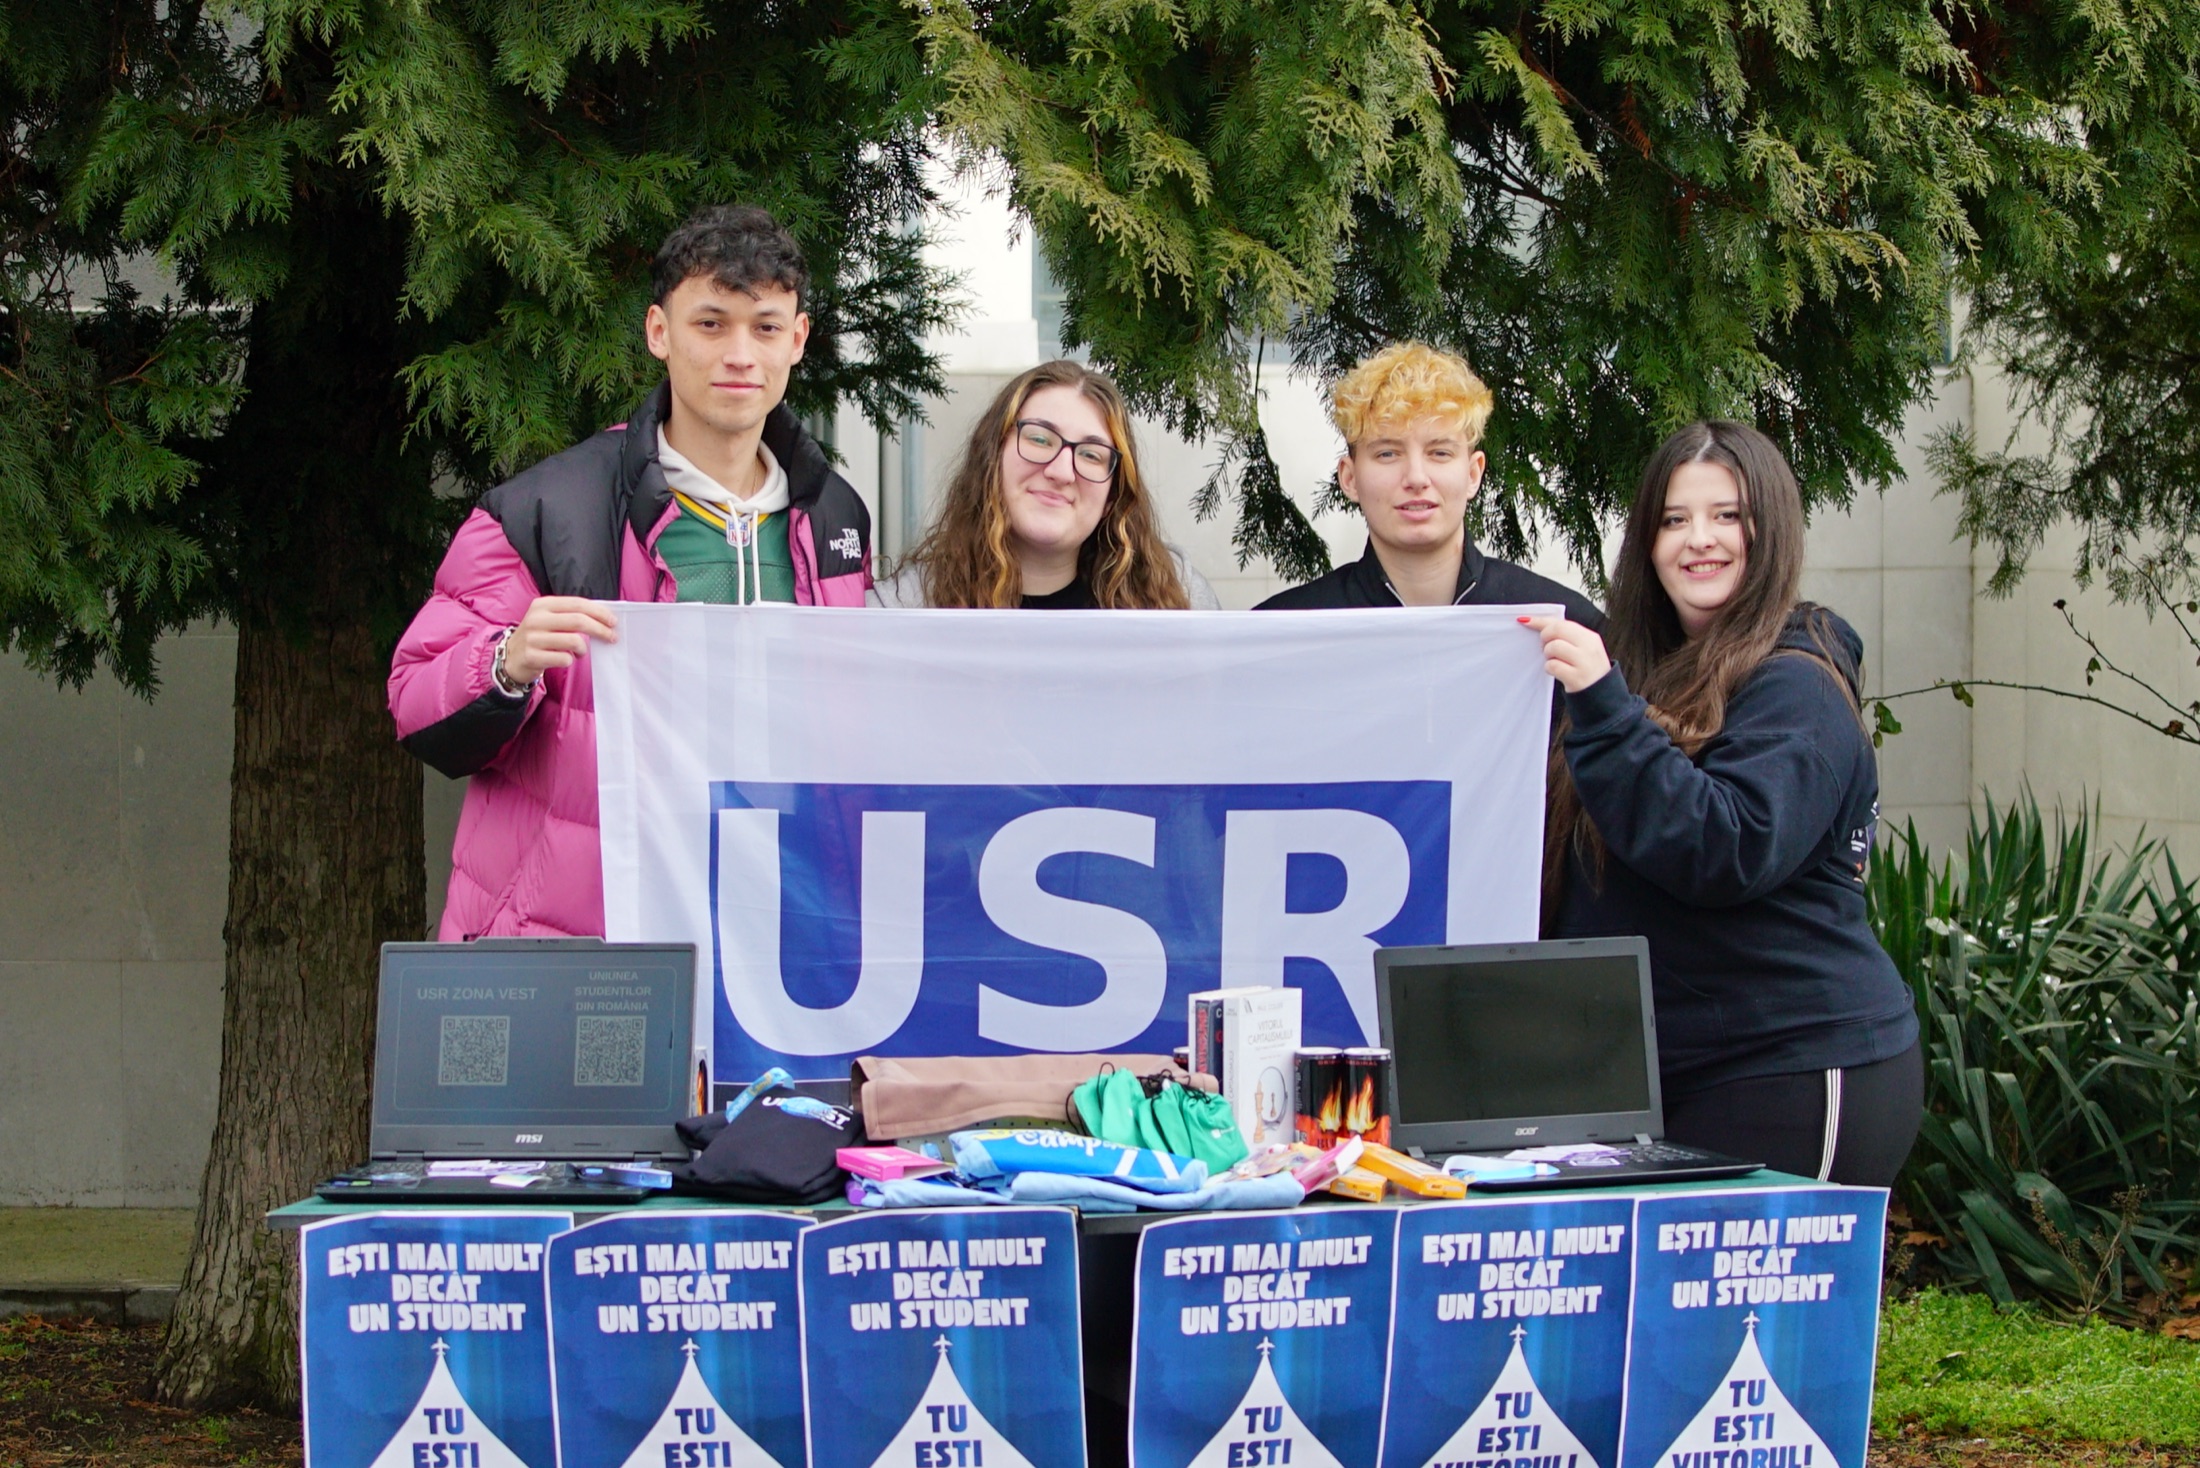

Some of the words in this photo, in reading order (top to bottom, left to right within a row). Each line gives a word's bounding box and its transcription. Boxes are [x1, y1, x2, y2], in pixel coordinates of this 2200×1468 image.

[842, 549, 861, 559] FAC
[717, 806, 1411, 1056] USR
[588, 972, 638, 981] UNIUNEA
[417, 988, 448, 999] USR
[452, 988, 494, 999] ZONA
[499, 988, 537, 999] VEST
[576, 1002, 594, 1011] DIN
[1515, 1126, 1538, 1136] acer
[1423, 1233, 1481, 1267] EȘTI
[1489, 1230, 1545, 1259] MAI
[1553, 1225, 1624, 1255] MULT
[1659, 1222, 1715, 1254] EȘTI
[1723, 1219, 1779, 1248] MAI
[1786, 1215, 1857, 1244] MULT
[328, 1243, 389, 1277] EȘTI
[398, 1243, 458, 1270] MAI
[466, 1244, 543, 1271] MULT
[575, 1245, 637, 1278] EȘTI
[646, 1243, 708, 1271] MAI
[715, 1241, 792, 1270] MULT
[828, 1242, 890, 1276] EȘTI
[899, 1241, 961, 1268] MAI
[968, 1238, 1045, 1266] MULT
[1164, 1246, 1224, 1279] EȘTI
[1232, 1243, 1290, 1271] MAI
[1299, 1236, 1372, 1267] MULT
[1480, 1256, 1564, 1290] DECÂT
[1714, 1245, 1796, 1279] DECÂT
[392, 1271, 481, 1303] DECÂT
[640, 1271, 730, 1303] DECÂT
[893, 1267, 983, 1299] DECÂT
[1224, 1269, 1310, 1303] DECÂT
[1673, 1281, 1709, 1309] UN
[1716, 1274, 1834, 1306] STUDENT
[349, 1304, 389, 1332] UN
[398, 1303, 525, 1330] STUDENT
[599, 1305, 638, 1333] UN
[647, 1302, 776, 1331] STUDENT
[851, 1302, 891, 1331] UN
[900, 1298, 1029, 1328] STUDENT
[1181, 1306, 1219, 1335] UN
[1227, 1297, 1350, 1332] STUDENT
[1438, 1293, 1475, 1321] UN
[1482, 1286, 1602, 1318] STUDENT
[1496, 1393, 1532, 1419] TU
[1730, 1380, 1765, 1407] TU
[424, 1409, 463, 1434] TU
[675, 1409, 715, 1435] TU
[927, 1406, 966, 1432] TU
[1245, 1407, 1282, 1433] TU
[1714, 1414, 1774, 1447] EȘTI
[1478, 1426, 1541, 1457] EȘTI
